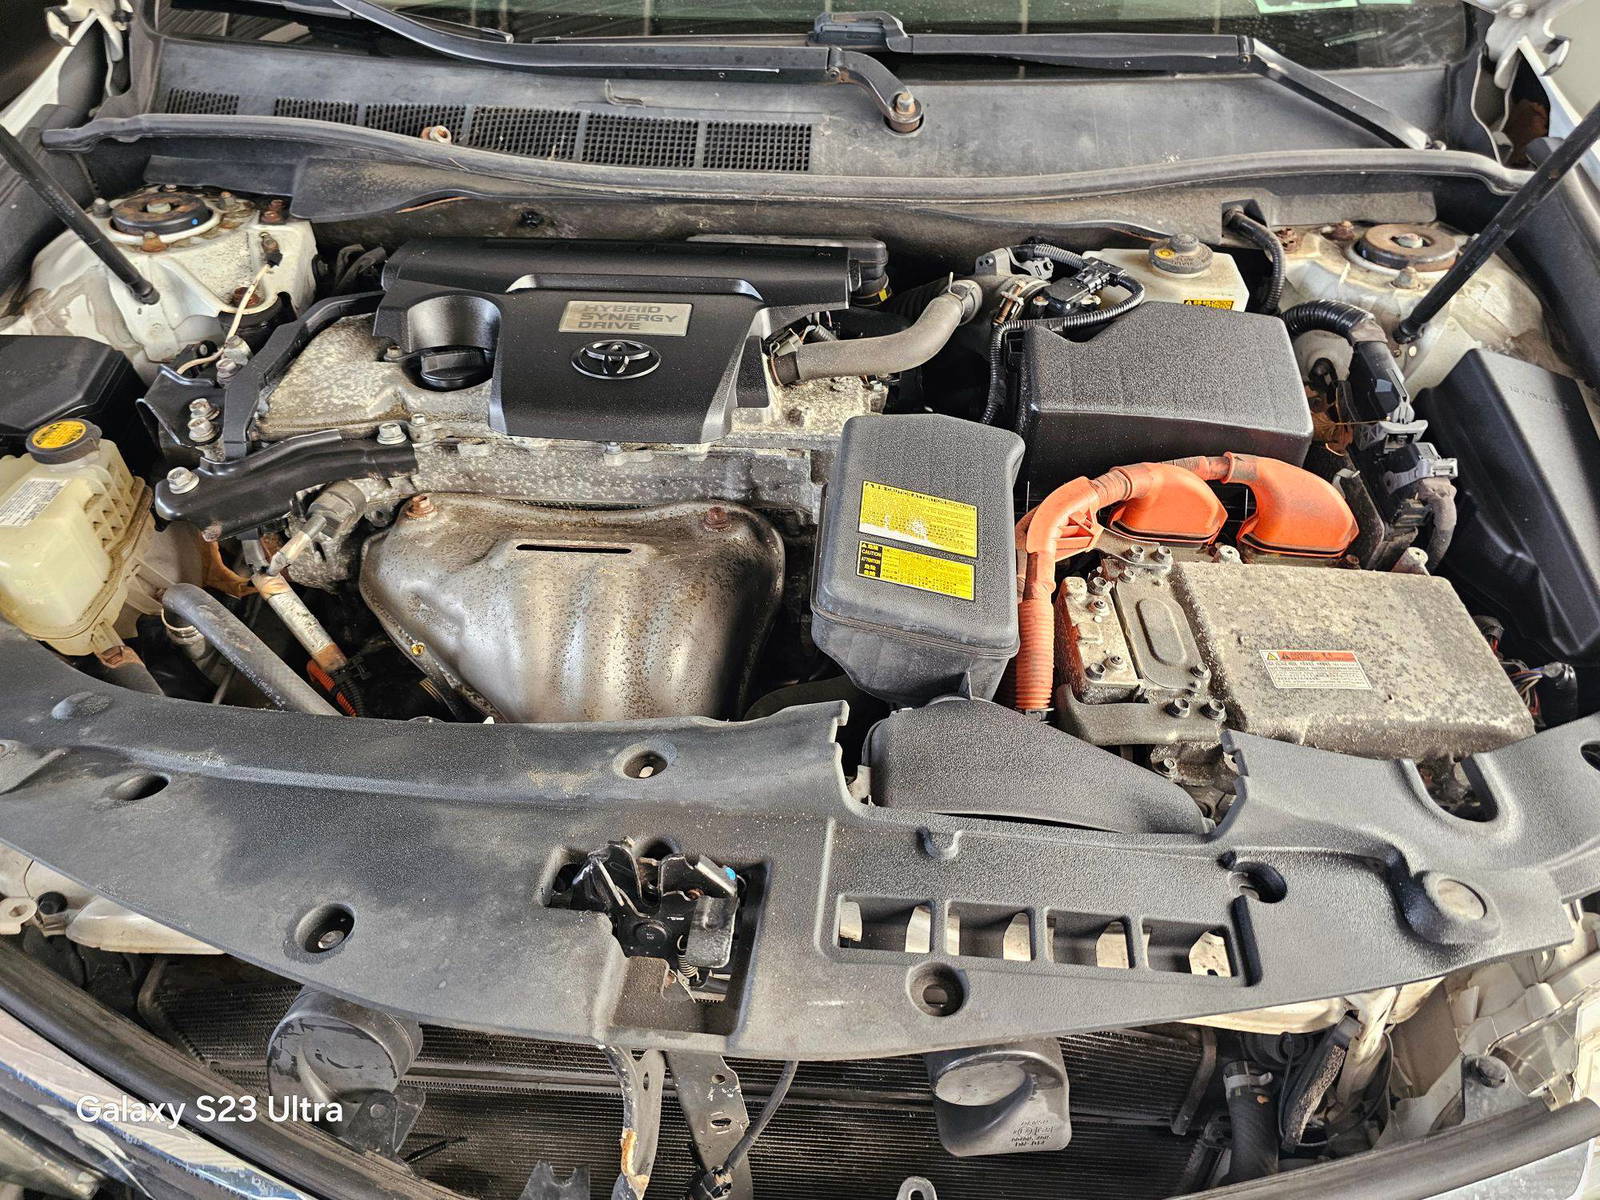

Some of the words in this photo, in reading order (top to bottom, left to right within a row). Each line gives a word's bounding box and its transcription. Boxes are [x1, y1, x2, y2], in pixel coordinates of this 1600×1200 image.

[584, 304, 662, 313] HYBRID
[580, 312, 678, 323] SYNERGY
[577, 321, 641, 330] DRIVE
